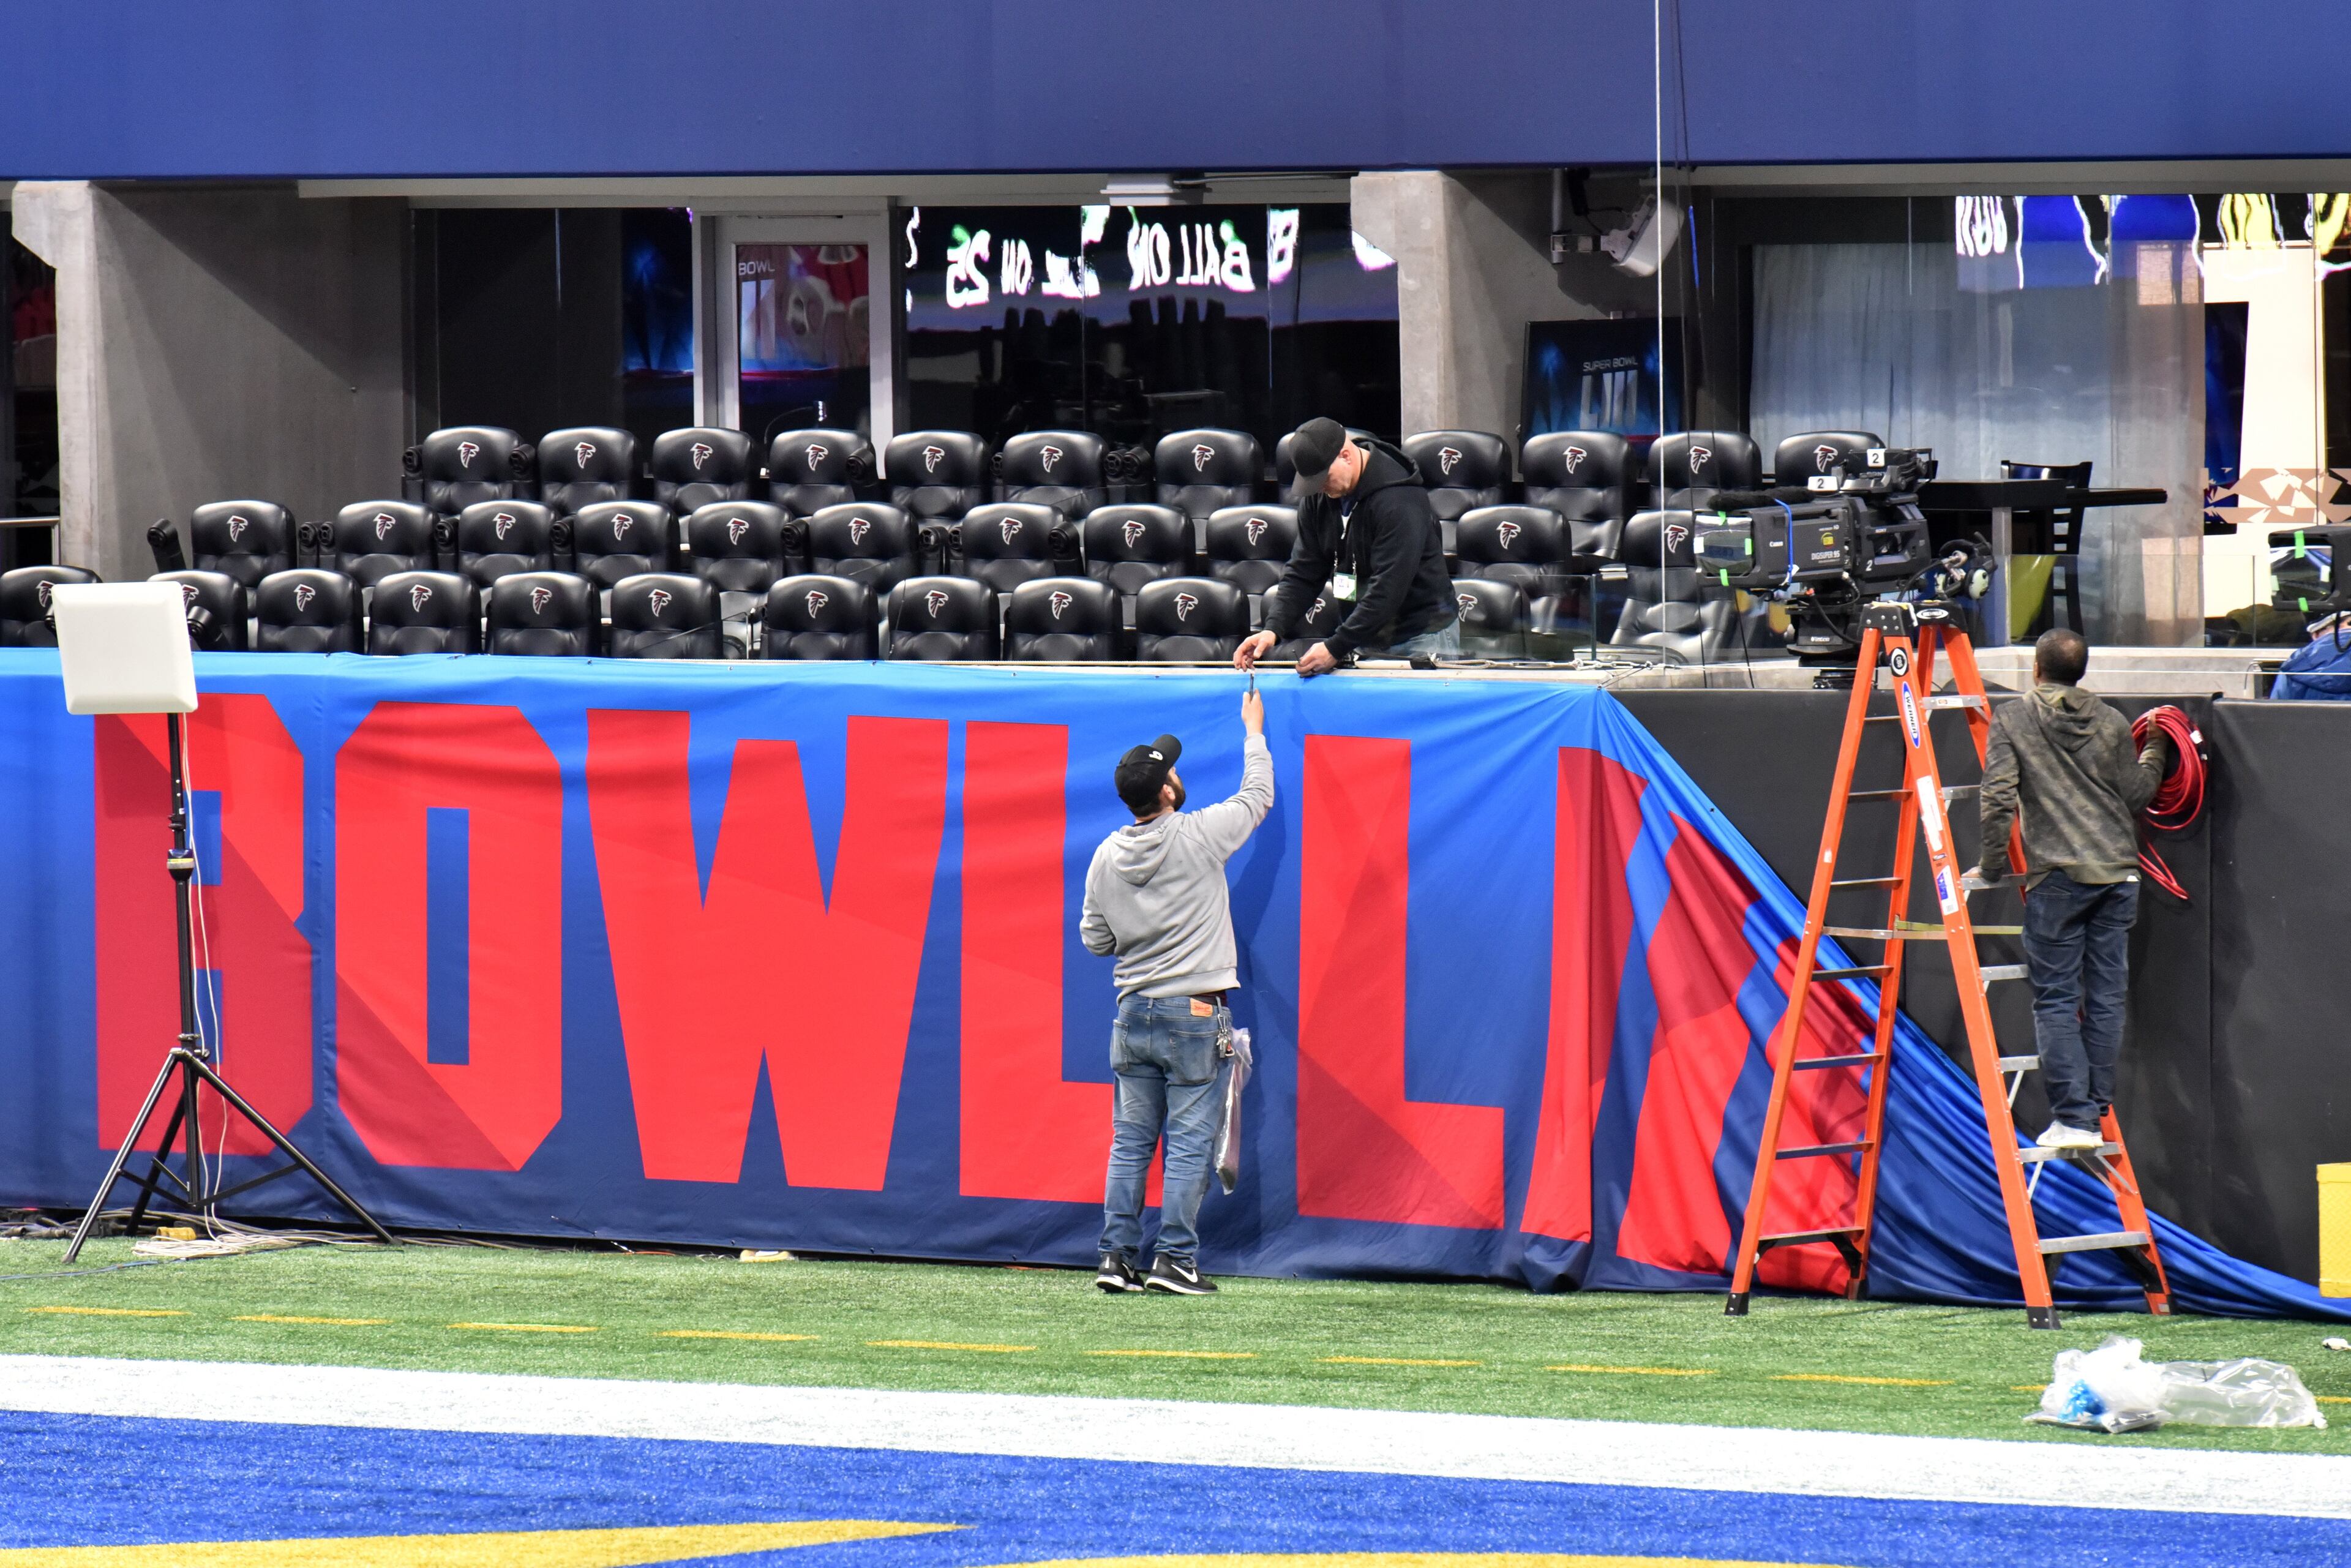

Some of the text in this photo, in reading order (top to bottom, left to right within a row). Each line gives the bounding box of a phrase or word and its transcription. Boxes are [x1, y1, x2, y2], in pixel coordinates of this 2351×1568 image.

[738, 260, 776, 276] BOWL
[1583, 356, 1638, 372] SUPER BOWL
[1872, 452, 1880, 464] 2
[1817, 478, 1824, 489] 2
[1865, 560, 1873, 571] 2
[1905, 696, 1918, 735] WERNER
[94, 693, 1161, 1207] BOWL
